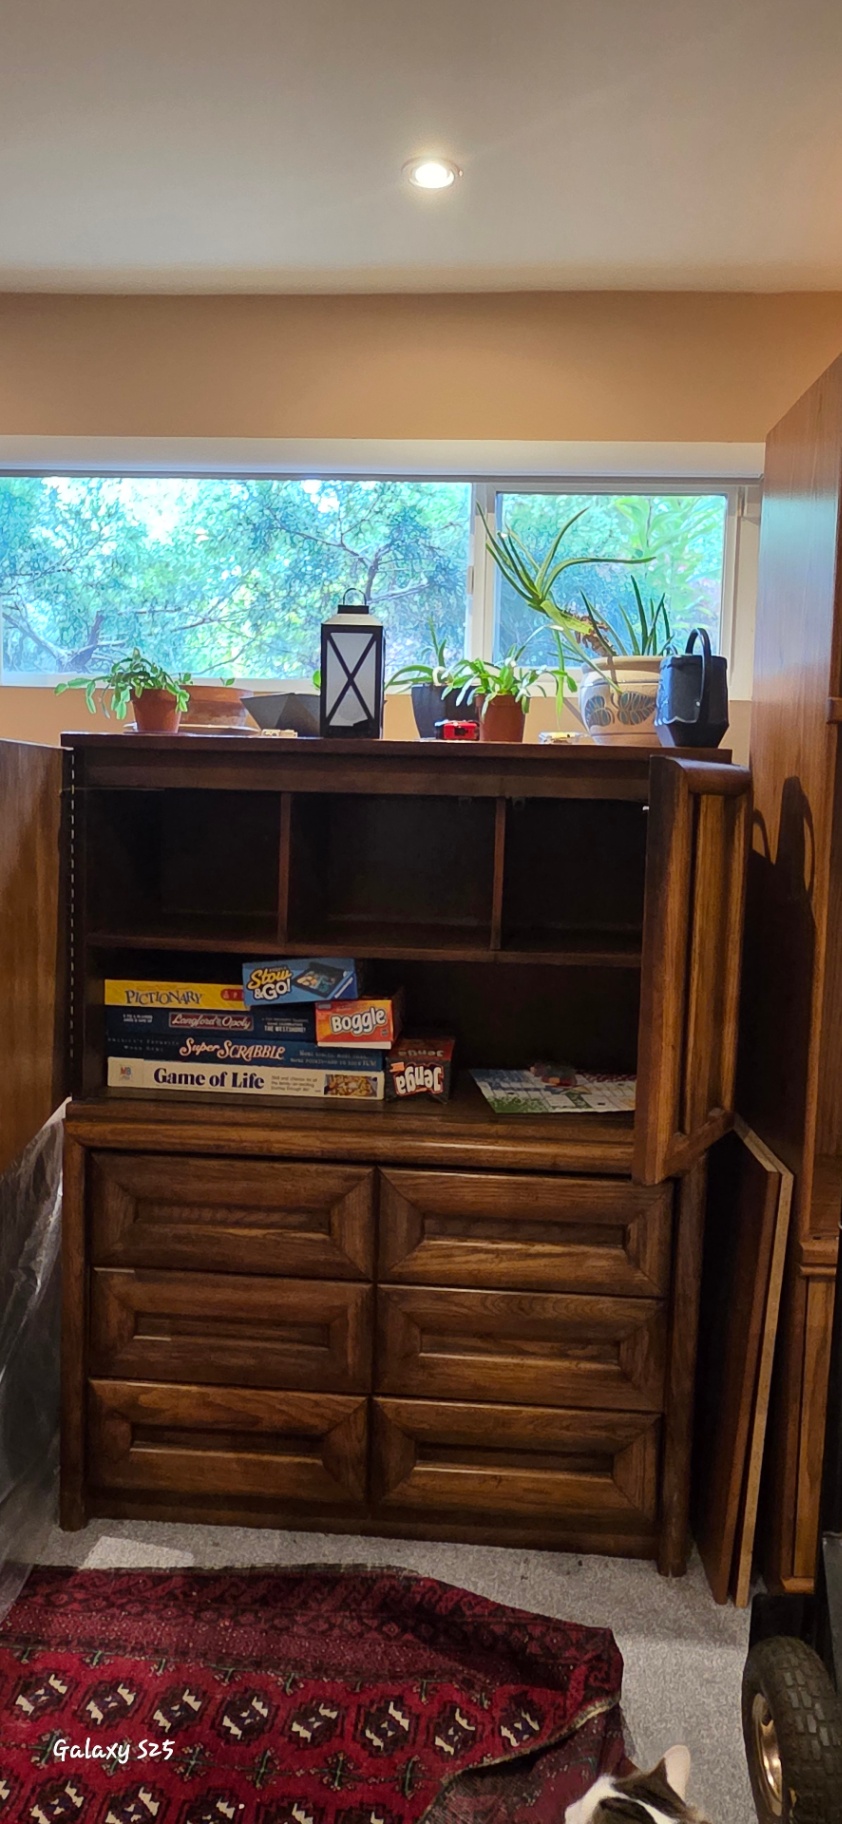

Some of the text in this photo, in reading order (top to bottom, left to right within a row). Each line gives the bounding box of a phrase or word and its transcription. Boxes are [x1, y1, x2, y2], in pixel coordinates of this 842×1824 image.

[247, 968, 292, 989] Stow
[254, 978, 291, 1000] &GO!
[124, 989, 204, 1005] PICTIONARY
[331, 1007, 386, 1034] Boggle
[179, 1037, 286, 1062] Super SCRABBLE
[153, 1067, 206, 1086] Game
[208, 1071, 228, 1087] of
[231, 1072, 264, 1089] Life
[395, 1065, 442, 1094] Jenga
